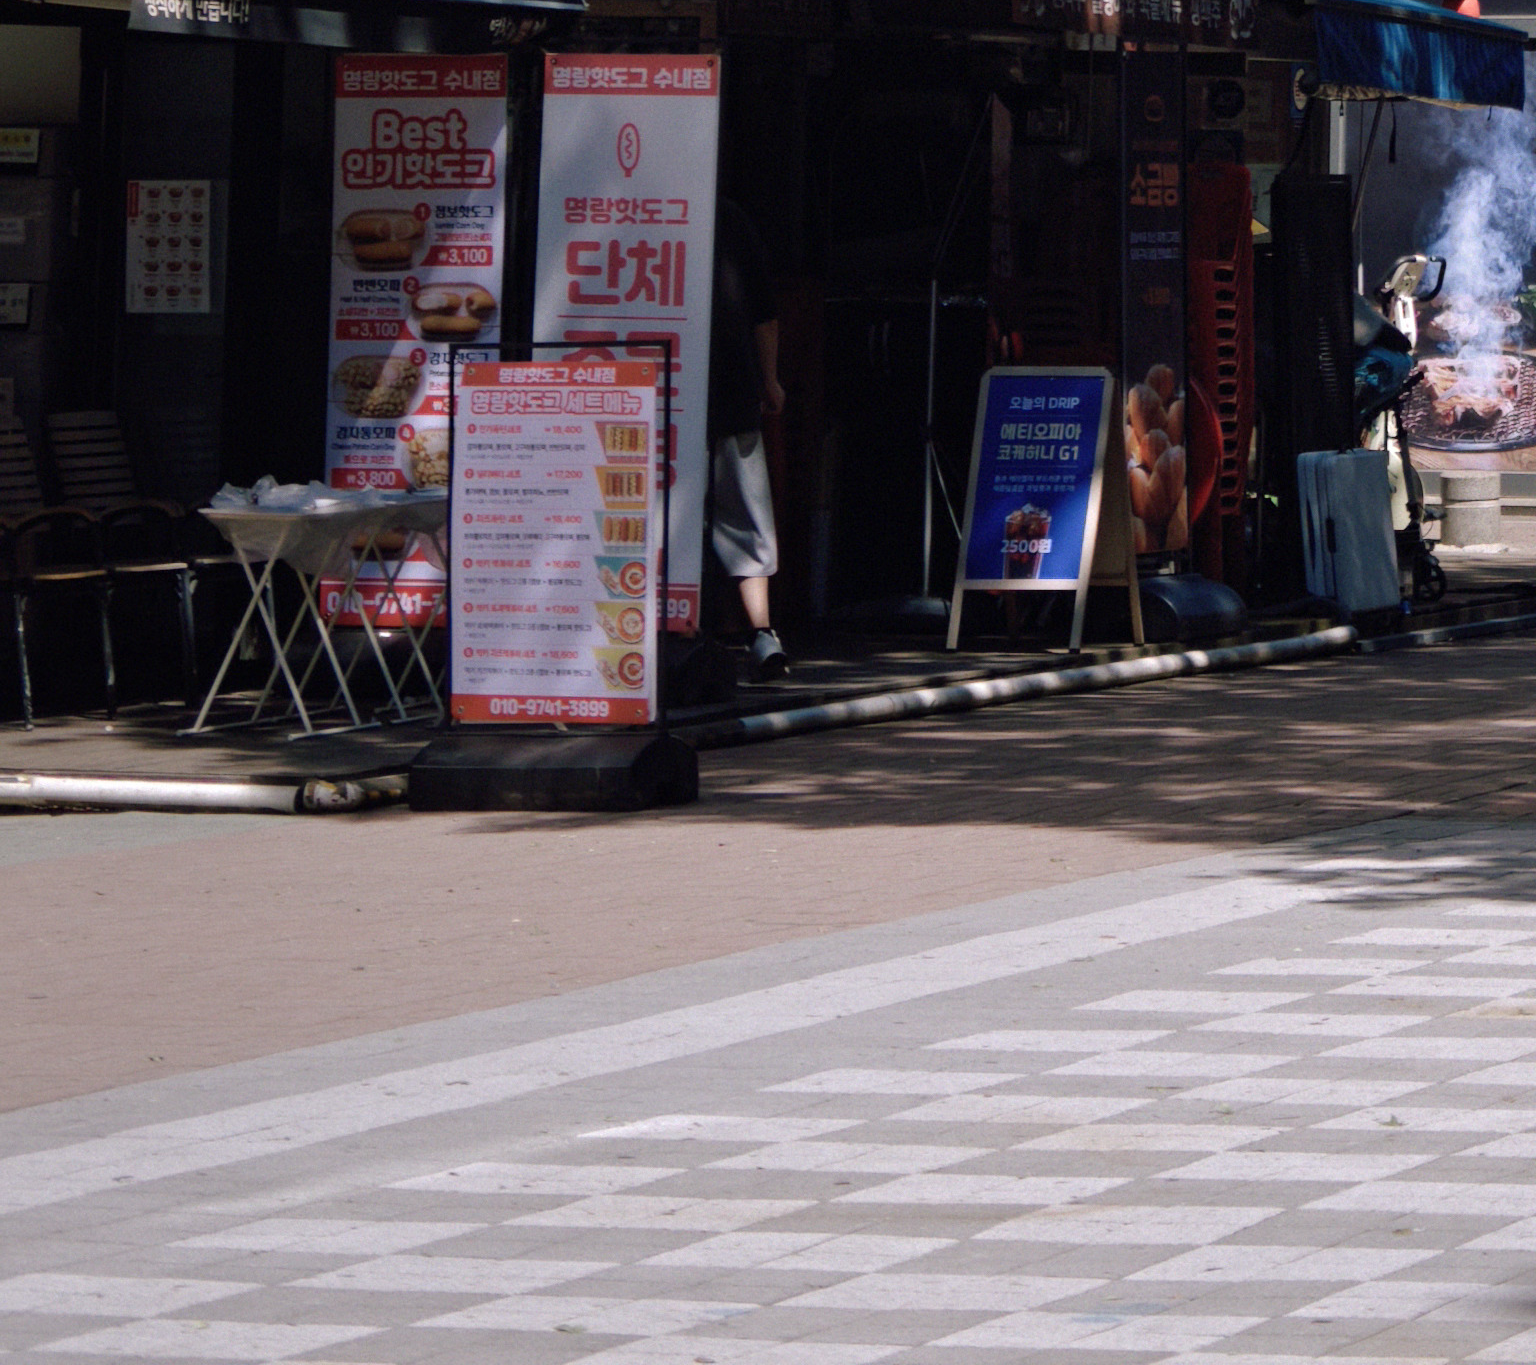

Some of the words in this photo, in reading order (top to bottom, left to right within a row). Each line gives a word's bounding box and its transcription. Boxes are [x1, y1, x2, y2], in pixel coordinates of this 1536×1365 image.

[342, 70, 440, 92] 명랑핫도그
[447, 69, 501, 91] 수내점
[552, 66, 648, 90] 명랑핫도그
[653, 67, 712, 90] 수내점
[376, 112, 467, 151] Best
[343, 152, 493, 186] 인기핫도그
[563, 196, 690, 226] 명랑핫도그
[565, 239, 688, 308] 단체
[498, 366, 570, 384] 명랑핫도그
[573, 366, 616, 384] 수내점
[472, 390, 562, 415] 명랑핫도그
[564, 390, 643, 416] 세트메뉴
[1009, 396, 1046, 410] 오늘의
[1048, 396, 1081, 410] DRIP
[1000, 422, 1082, 441] 에티오피아
[1058, 445, 1079, 461] G1
[1001, 538, 1053, 554] 2500원
[489, 697, 610, 717] 010-9741-3899
